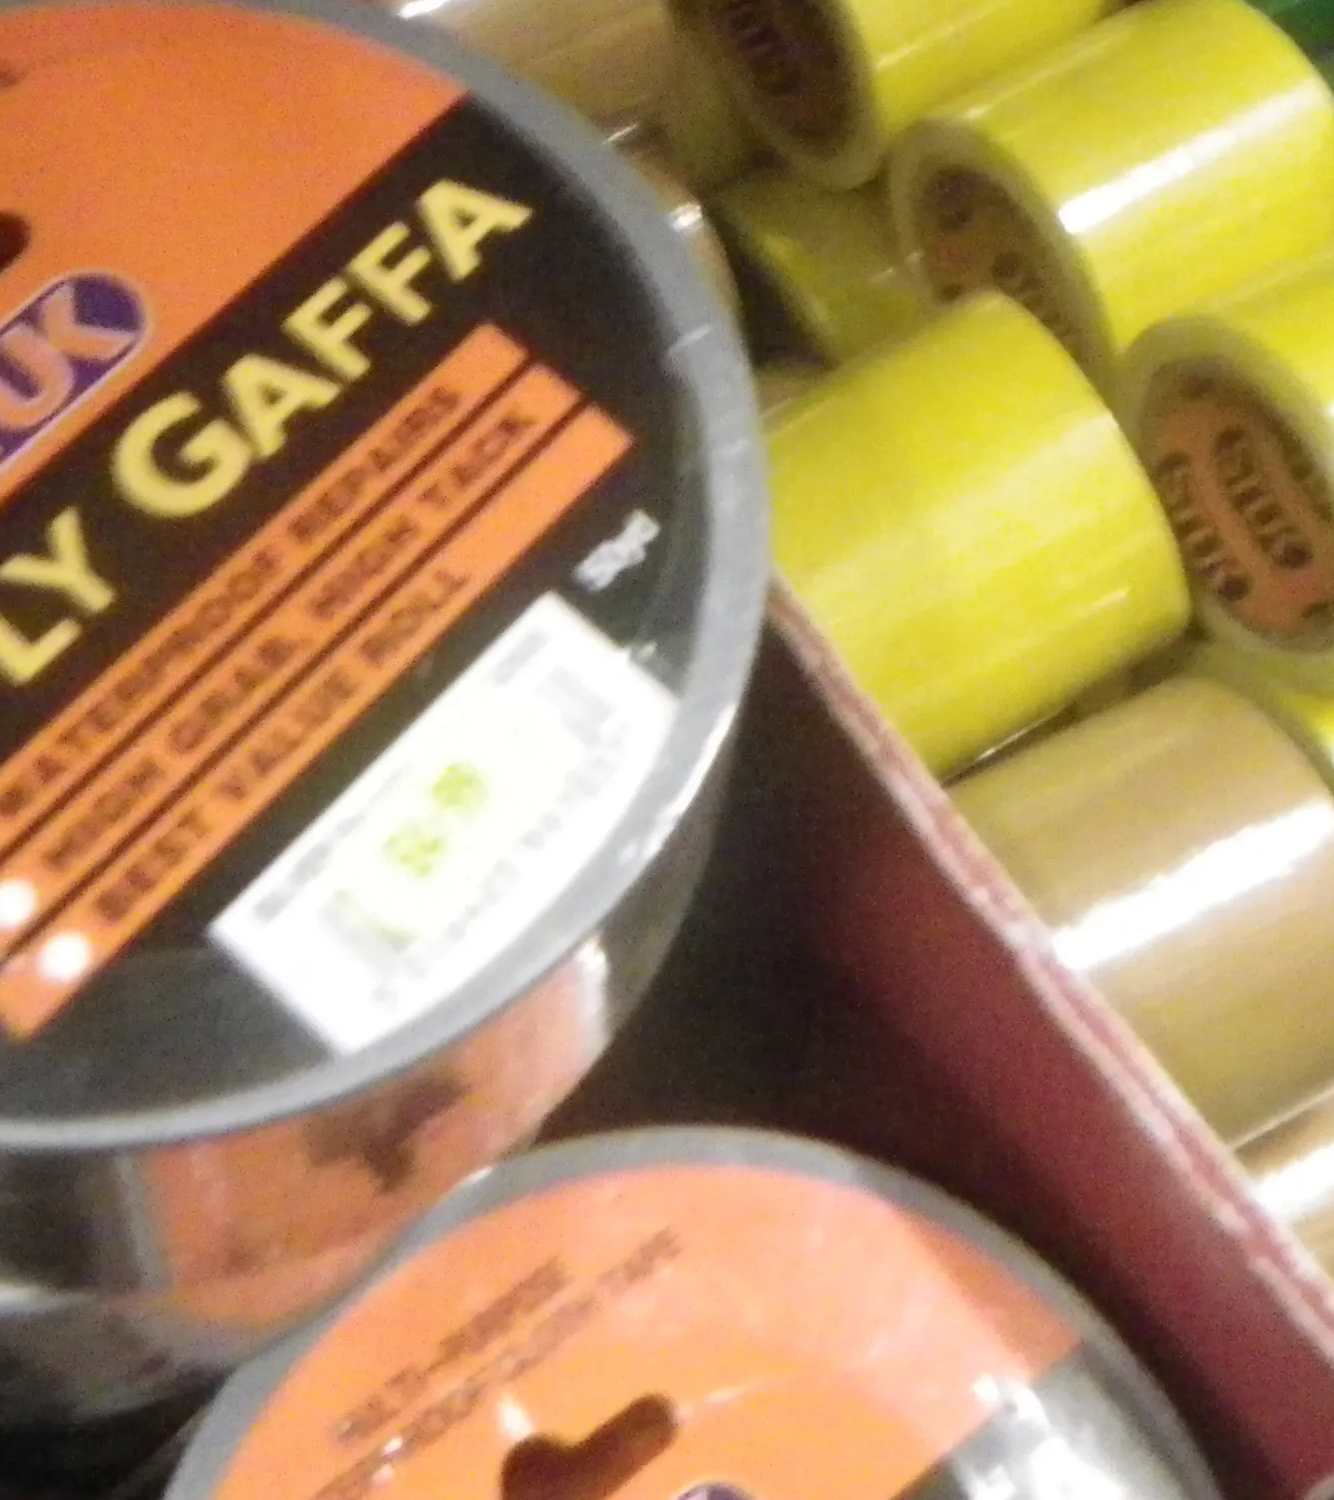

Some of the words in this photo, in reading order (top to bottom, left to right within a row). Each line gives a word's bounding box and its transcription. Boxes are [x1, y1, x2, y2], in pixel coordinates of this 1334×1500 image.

[113, 177, 533, 517] GAFFA
[282, 374, 469, 551] REPAIRS
[36, 754, 169, 881] HIGH
[305, 511, 424, 624] HIGH
[420, 399, 542, 516] TACK
[86, 804, 216, 929] BEST
[210, 669, 357, 809] VALUE
[356, 559, 473, 672] ROLL
